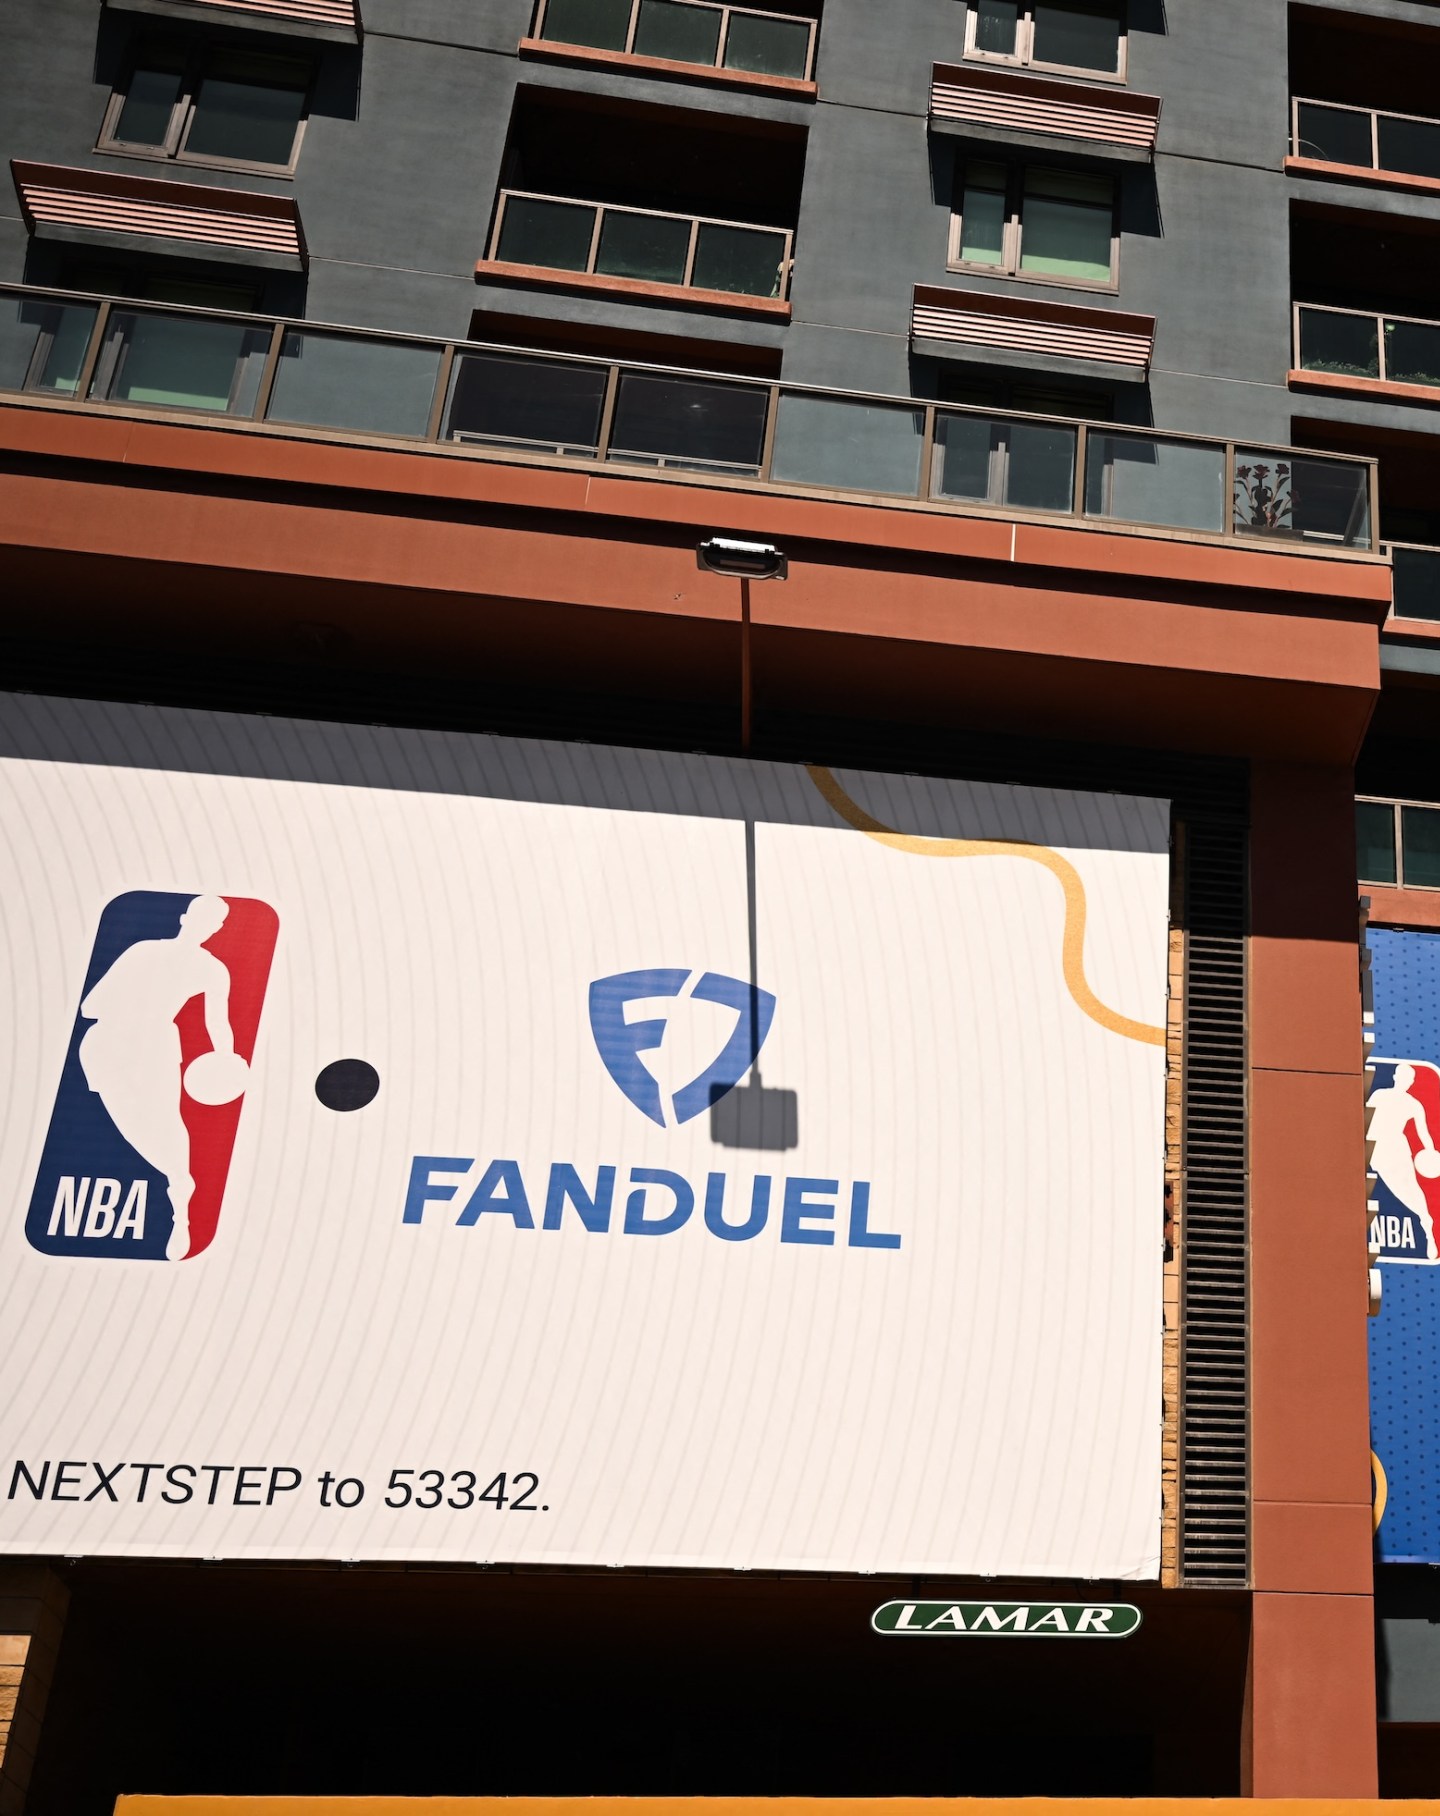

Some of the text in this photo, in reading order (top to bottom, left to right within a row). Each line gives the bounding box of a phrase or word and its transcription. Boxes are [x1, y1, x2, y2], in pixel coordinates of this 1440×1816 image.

[46, 1177, 149, 1241] NBA
[401, 1154, 902, 1250] FANDUEL
[1370, 1214, 1416, 1249] NBA
[7, 1460, 550, 1512] NEXTSTEP to 53342.
[894, 1605, 1114, 1632] LAMAR
